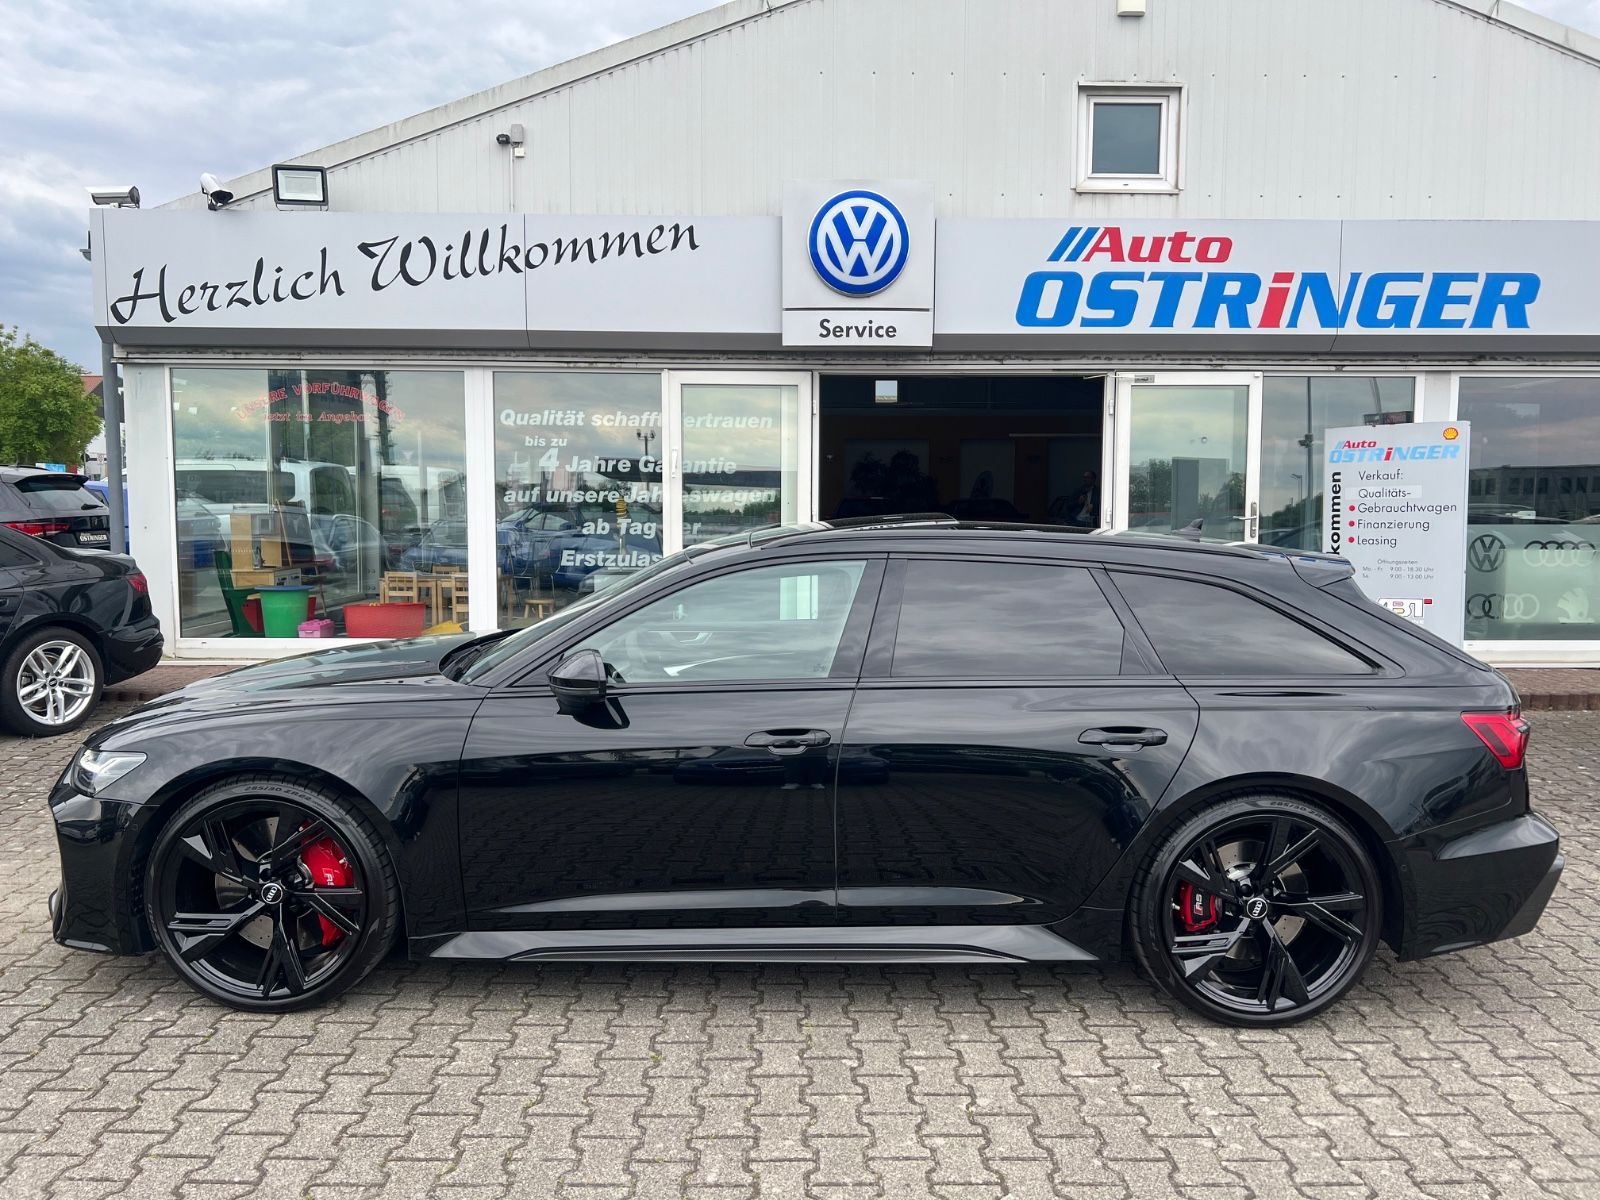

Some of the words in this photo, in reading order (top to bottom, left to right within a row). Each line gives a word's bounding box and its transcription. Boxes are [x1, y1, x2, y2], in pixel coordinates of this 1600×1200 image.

[1082, 226, 1233, 263] Auto
[110, 247, 344, 325] Herzlich
[357, 222, 700, 291] Willkommen
[819, 318, 897, 339] Service
[500, 408, 585, 427] Qualität
[684, 412, 773, 429] ertrauen
[524, 436, 546, 447] bis
[550, 437, 567, 447] zu
[1342, 440, 1377, 448] Auto
[538, 447, 560, 472] 4
[565, 455, 631, 473] Jahre
[638, 455, 737, 475] Gaantie
[1358, 469, 1404, 481] Verkauf:
[503, 486, 541, 503] auf
[546, 488, 620, 503] unsere
[623, 486, 776, 507] Jaheswagen
[1358, 487, 1412, 499] Qualitäts-
[1326, 471, 1342, 555] kommen
[1357, 501, 1457, 514] Gebrauchtwagen
[581, 518, 610, 535] ab
[617, 518, 657, 539] Tag
[682, 521, 702, 535] er
[1357, 518, 1430, 531] Finanzierung
[1357, 536, 1397, 548] Leasing
[560, 549, 663, 567] Erstzulas
